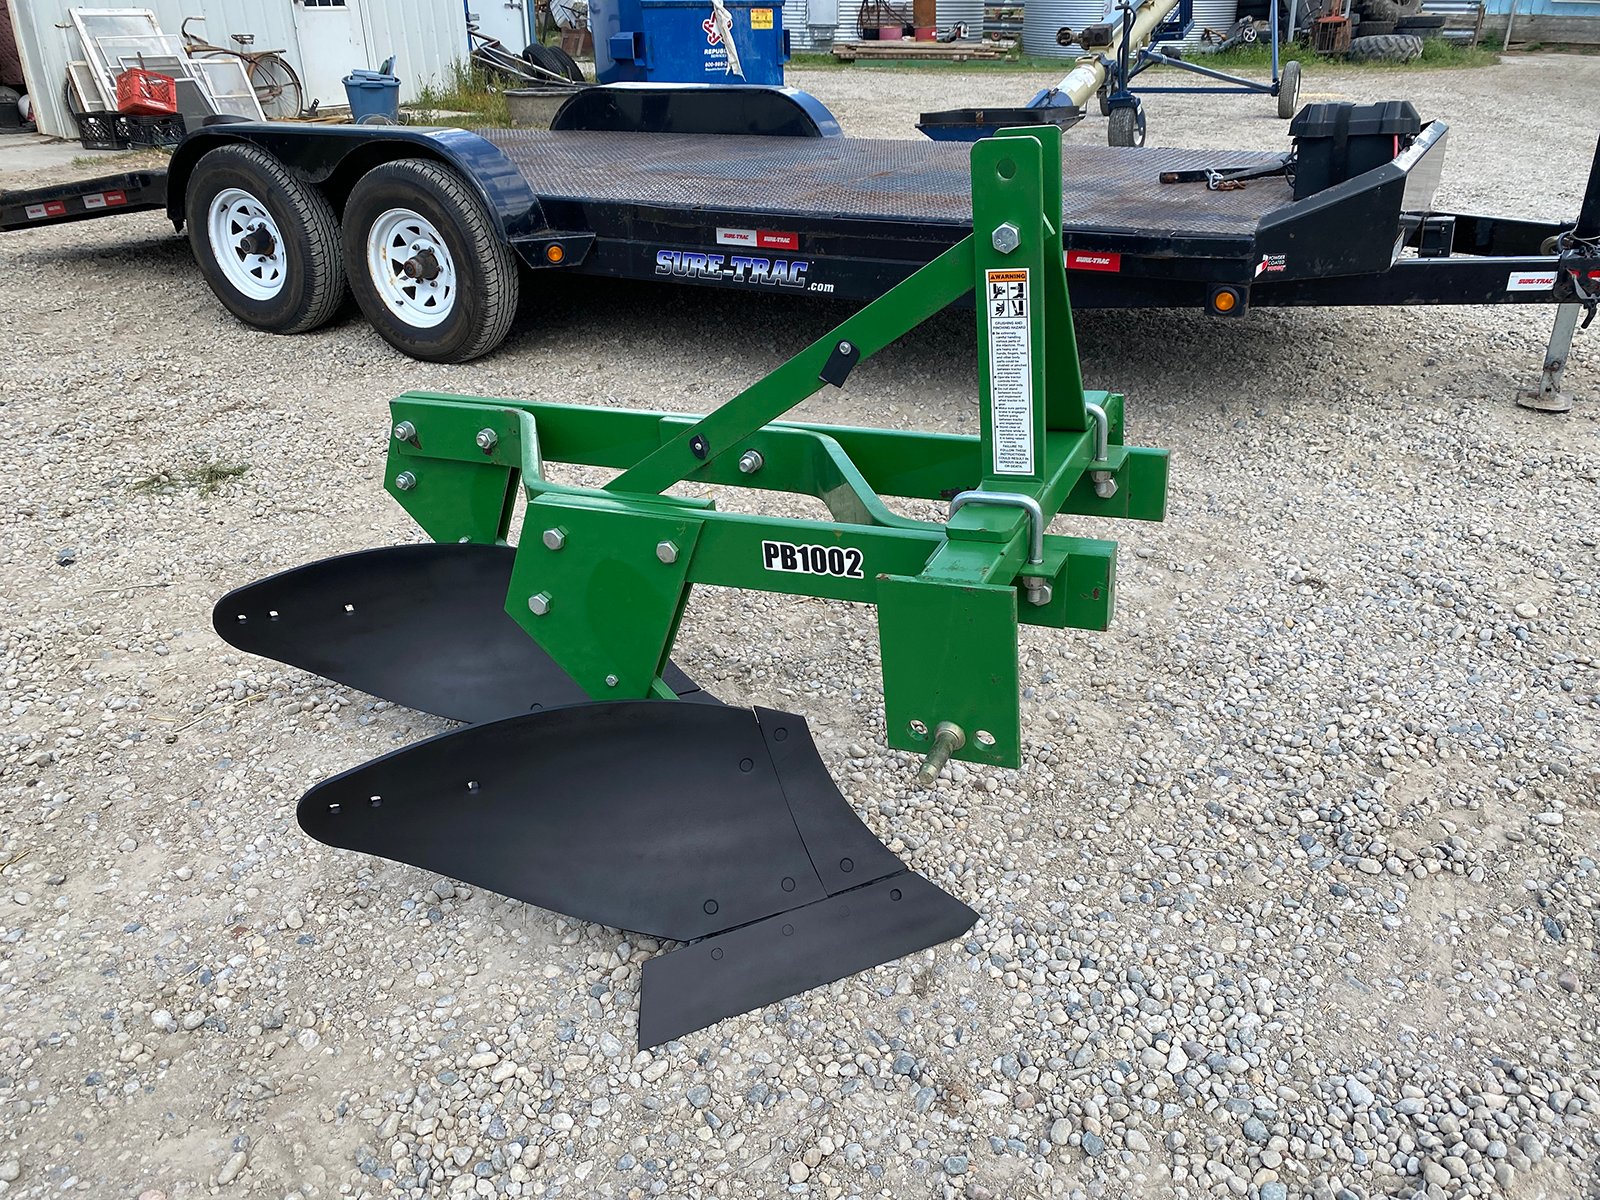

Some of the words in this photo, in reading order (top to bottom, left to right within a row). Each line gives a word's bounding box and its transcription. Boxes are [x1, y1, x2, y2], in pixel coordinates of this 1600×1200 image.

[655, 250, 808, 288] SURE-TRAC
[807, 282, 834, 293] .com
[1076, 256, 1110, 264] SURE-TRAC
[764, 542, 862, 577] PB1002
